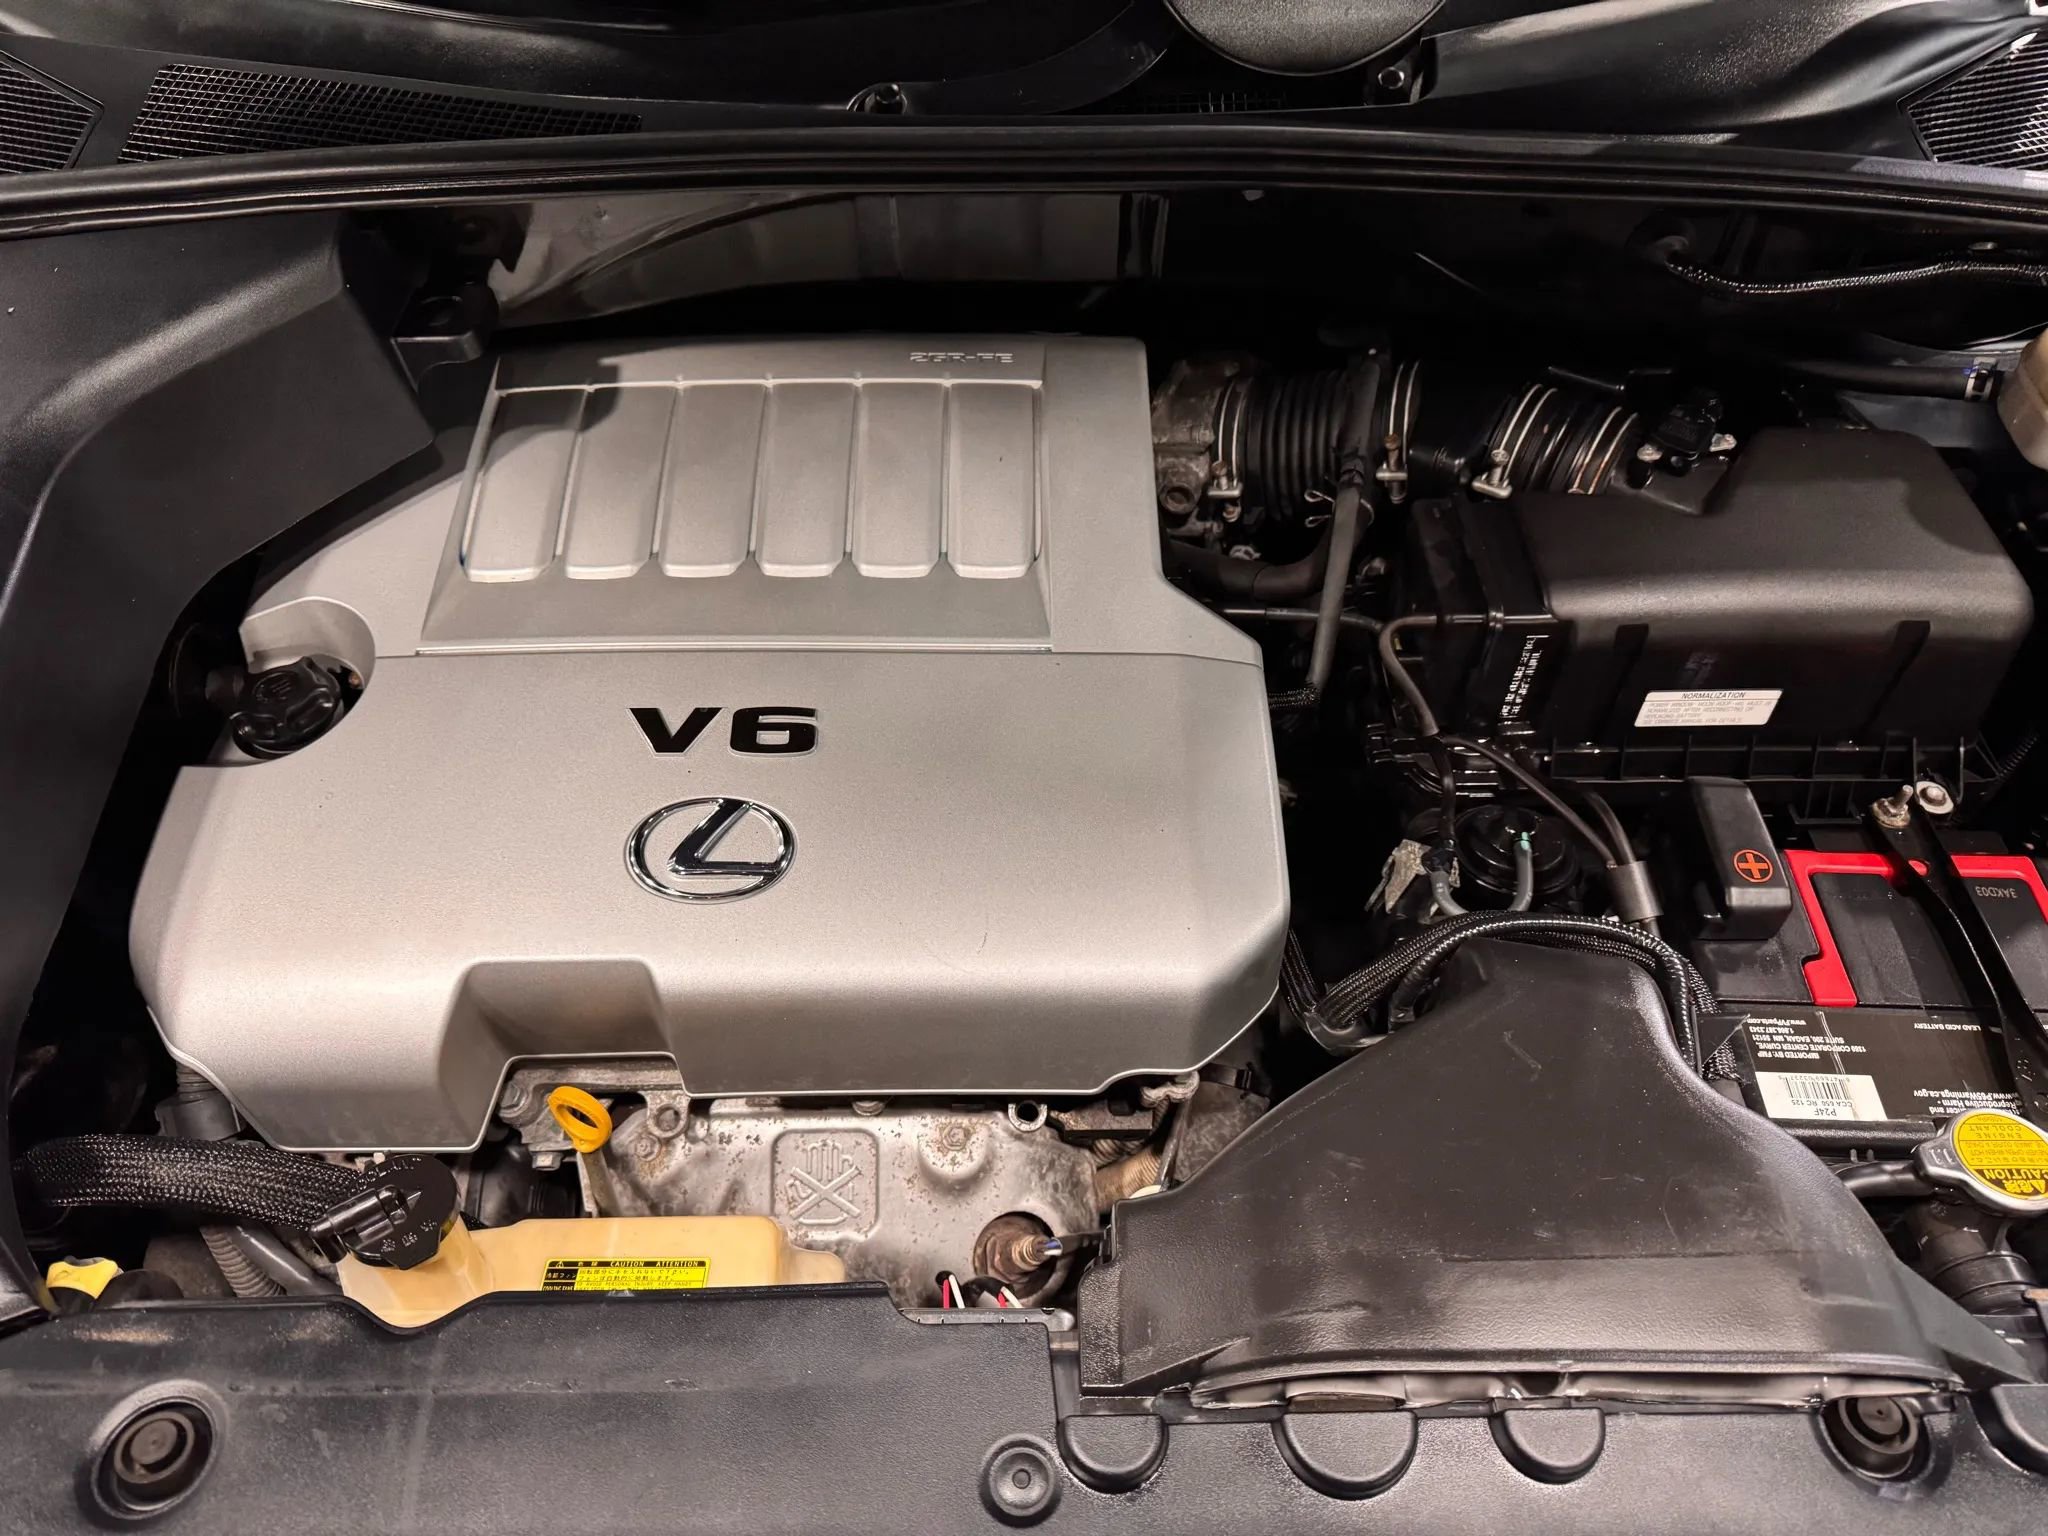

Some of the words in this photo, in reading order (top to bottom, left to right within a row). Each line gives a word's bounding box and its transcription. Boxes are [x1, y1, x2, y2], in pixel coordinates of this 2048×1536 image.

[629, 706, 817, 754] V6
[1782, 1043, 1808, 1051] CENTER
[1785, 1051, 1820, 1059] IMPORTED
[1942, 1099, 1964, 1107] Harm
[1965, 1100, 2016, 1109] Reproductive
[1814, 1108, 1837, 1116] P24F
[1929, 1106, 1944, 1114] and
[1983, 1169, 2048, 1179] CAUTION
